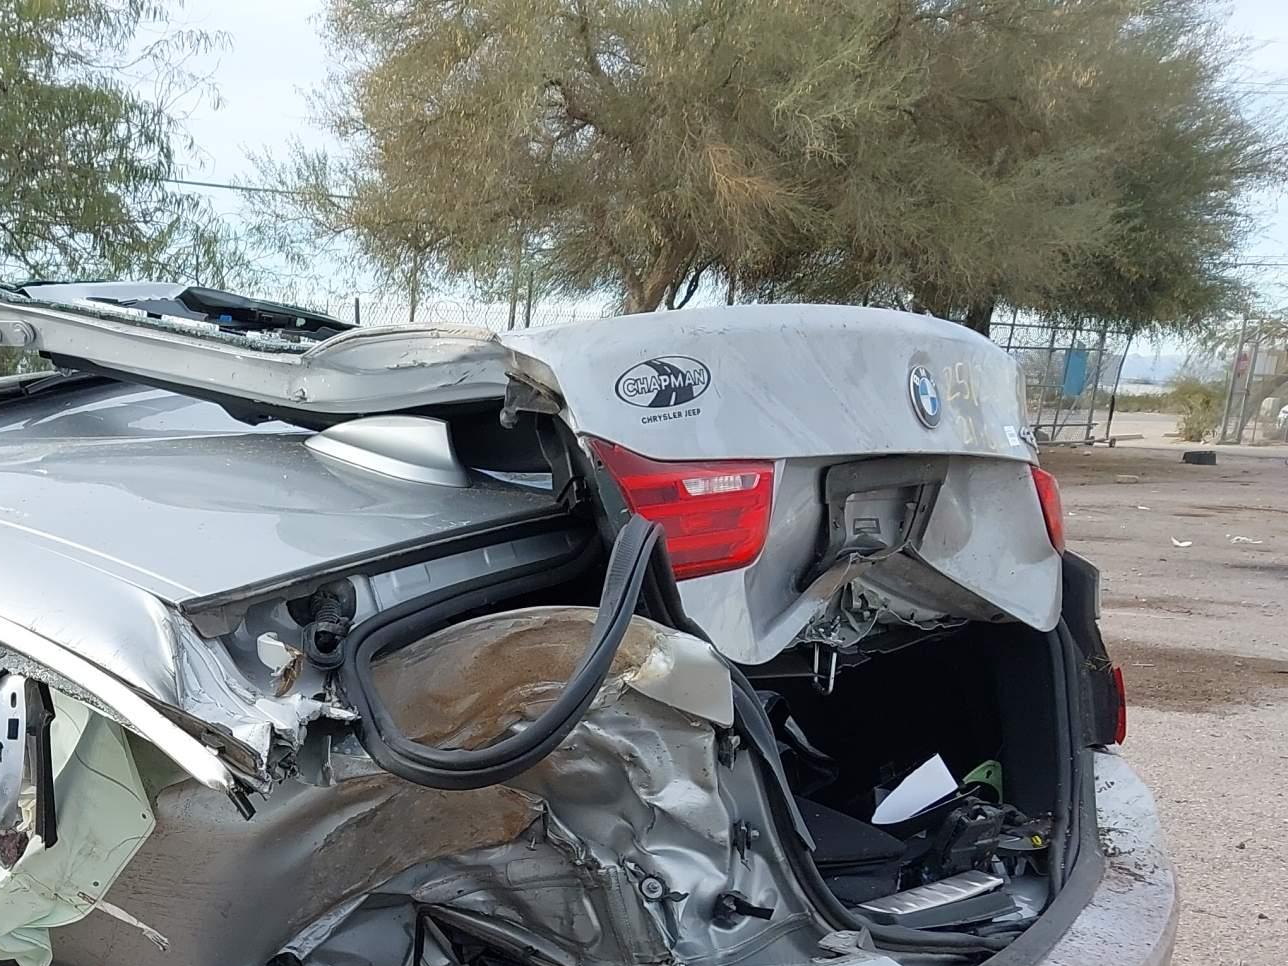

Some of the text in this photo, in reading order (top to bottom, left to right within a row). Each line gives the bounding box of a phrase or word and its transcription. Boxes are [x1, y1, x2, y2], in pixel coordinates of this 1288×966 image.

[622, 368, 705, 398] CHAPMAN
[641, 408, 701, 424] CHRYSLER JEEP
